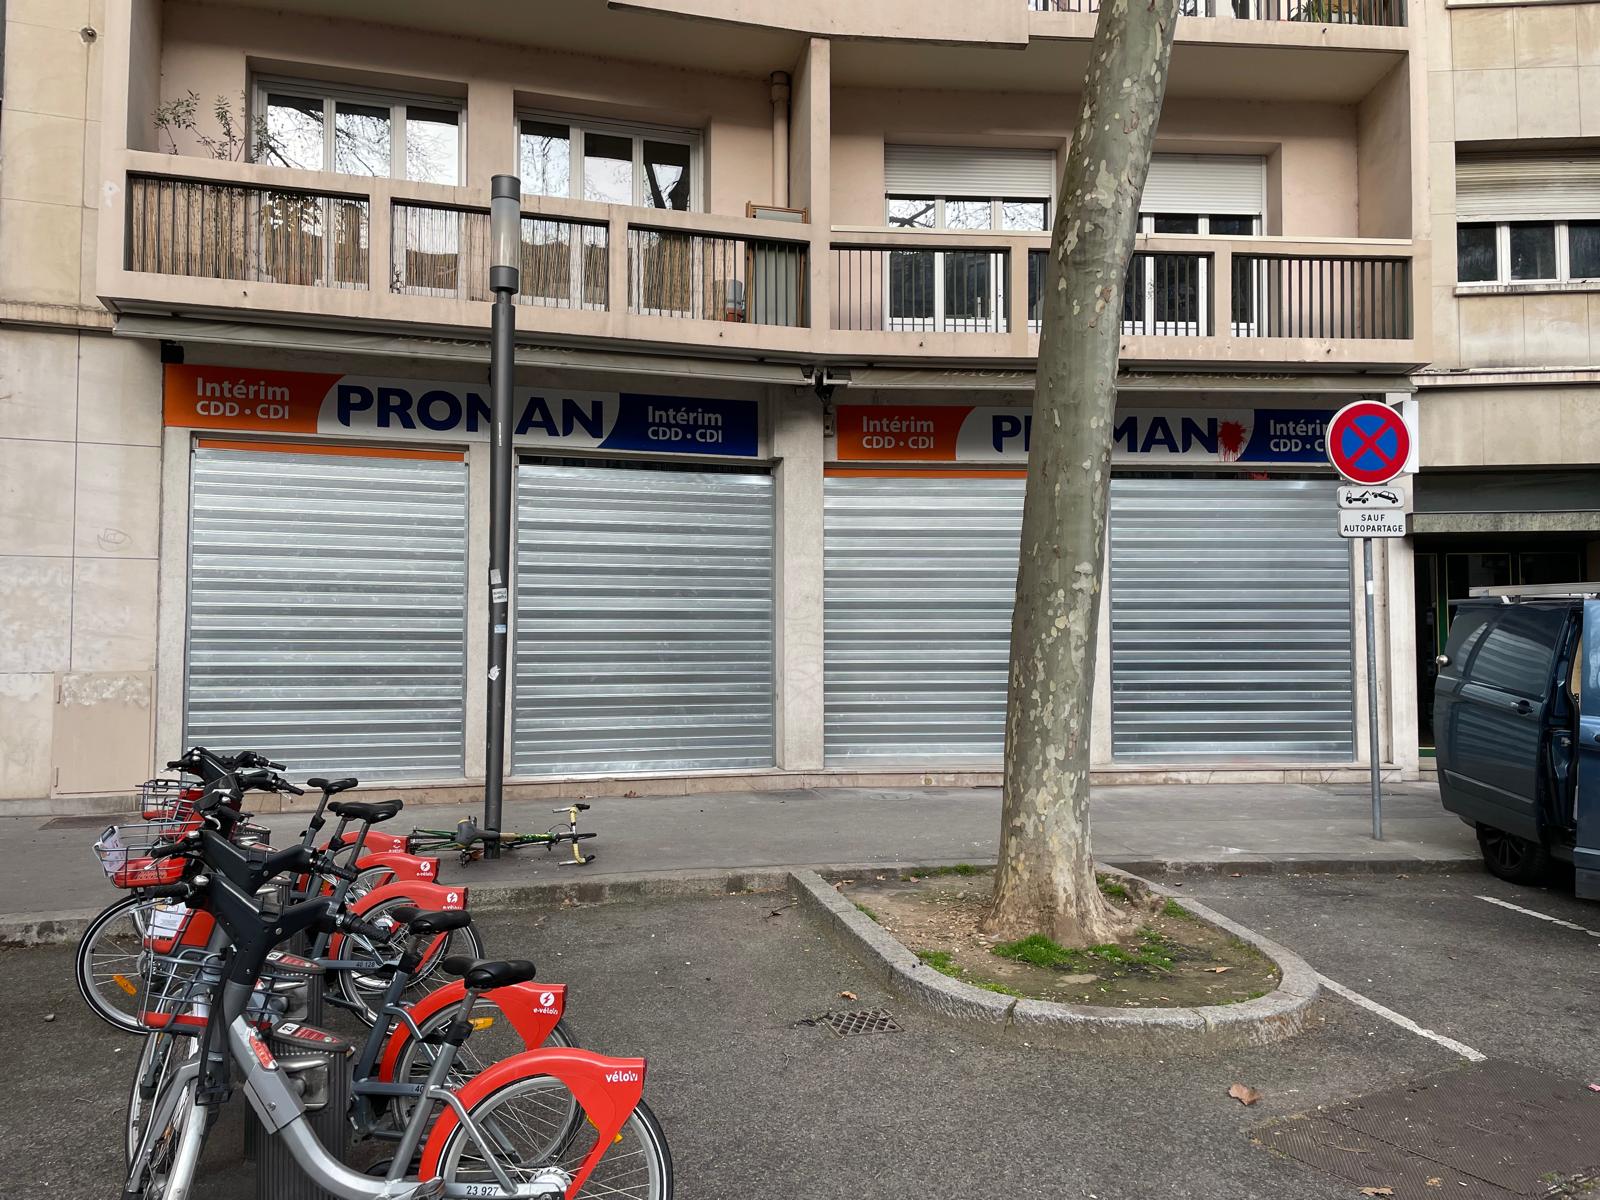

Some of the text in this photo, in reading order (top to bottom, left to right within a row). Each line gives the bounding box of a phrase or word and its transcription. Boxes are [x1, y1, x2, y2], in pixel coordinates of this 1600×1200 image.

[196, 376, 290, 401] Intérim
[195, 400, 289, 420] CDD CDI
[647, 405, 723, 427] Intérim
[862, 415, 935, 434] Intérim
[647, 428, 723, 444] CDD CDI
[991, 414, 1219, 454] PMAN
[862, 435, 935, 450] CDD CDI
[1269, 438, 1303, 452] CDD
[1361, 513, 1386, 522] SAUF
[1343, 524, 1404, 533] AUTOPARTAGE
[466, 1185, 499, 1196] 23 927
